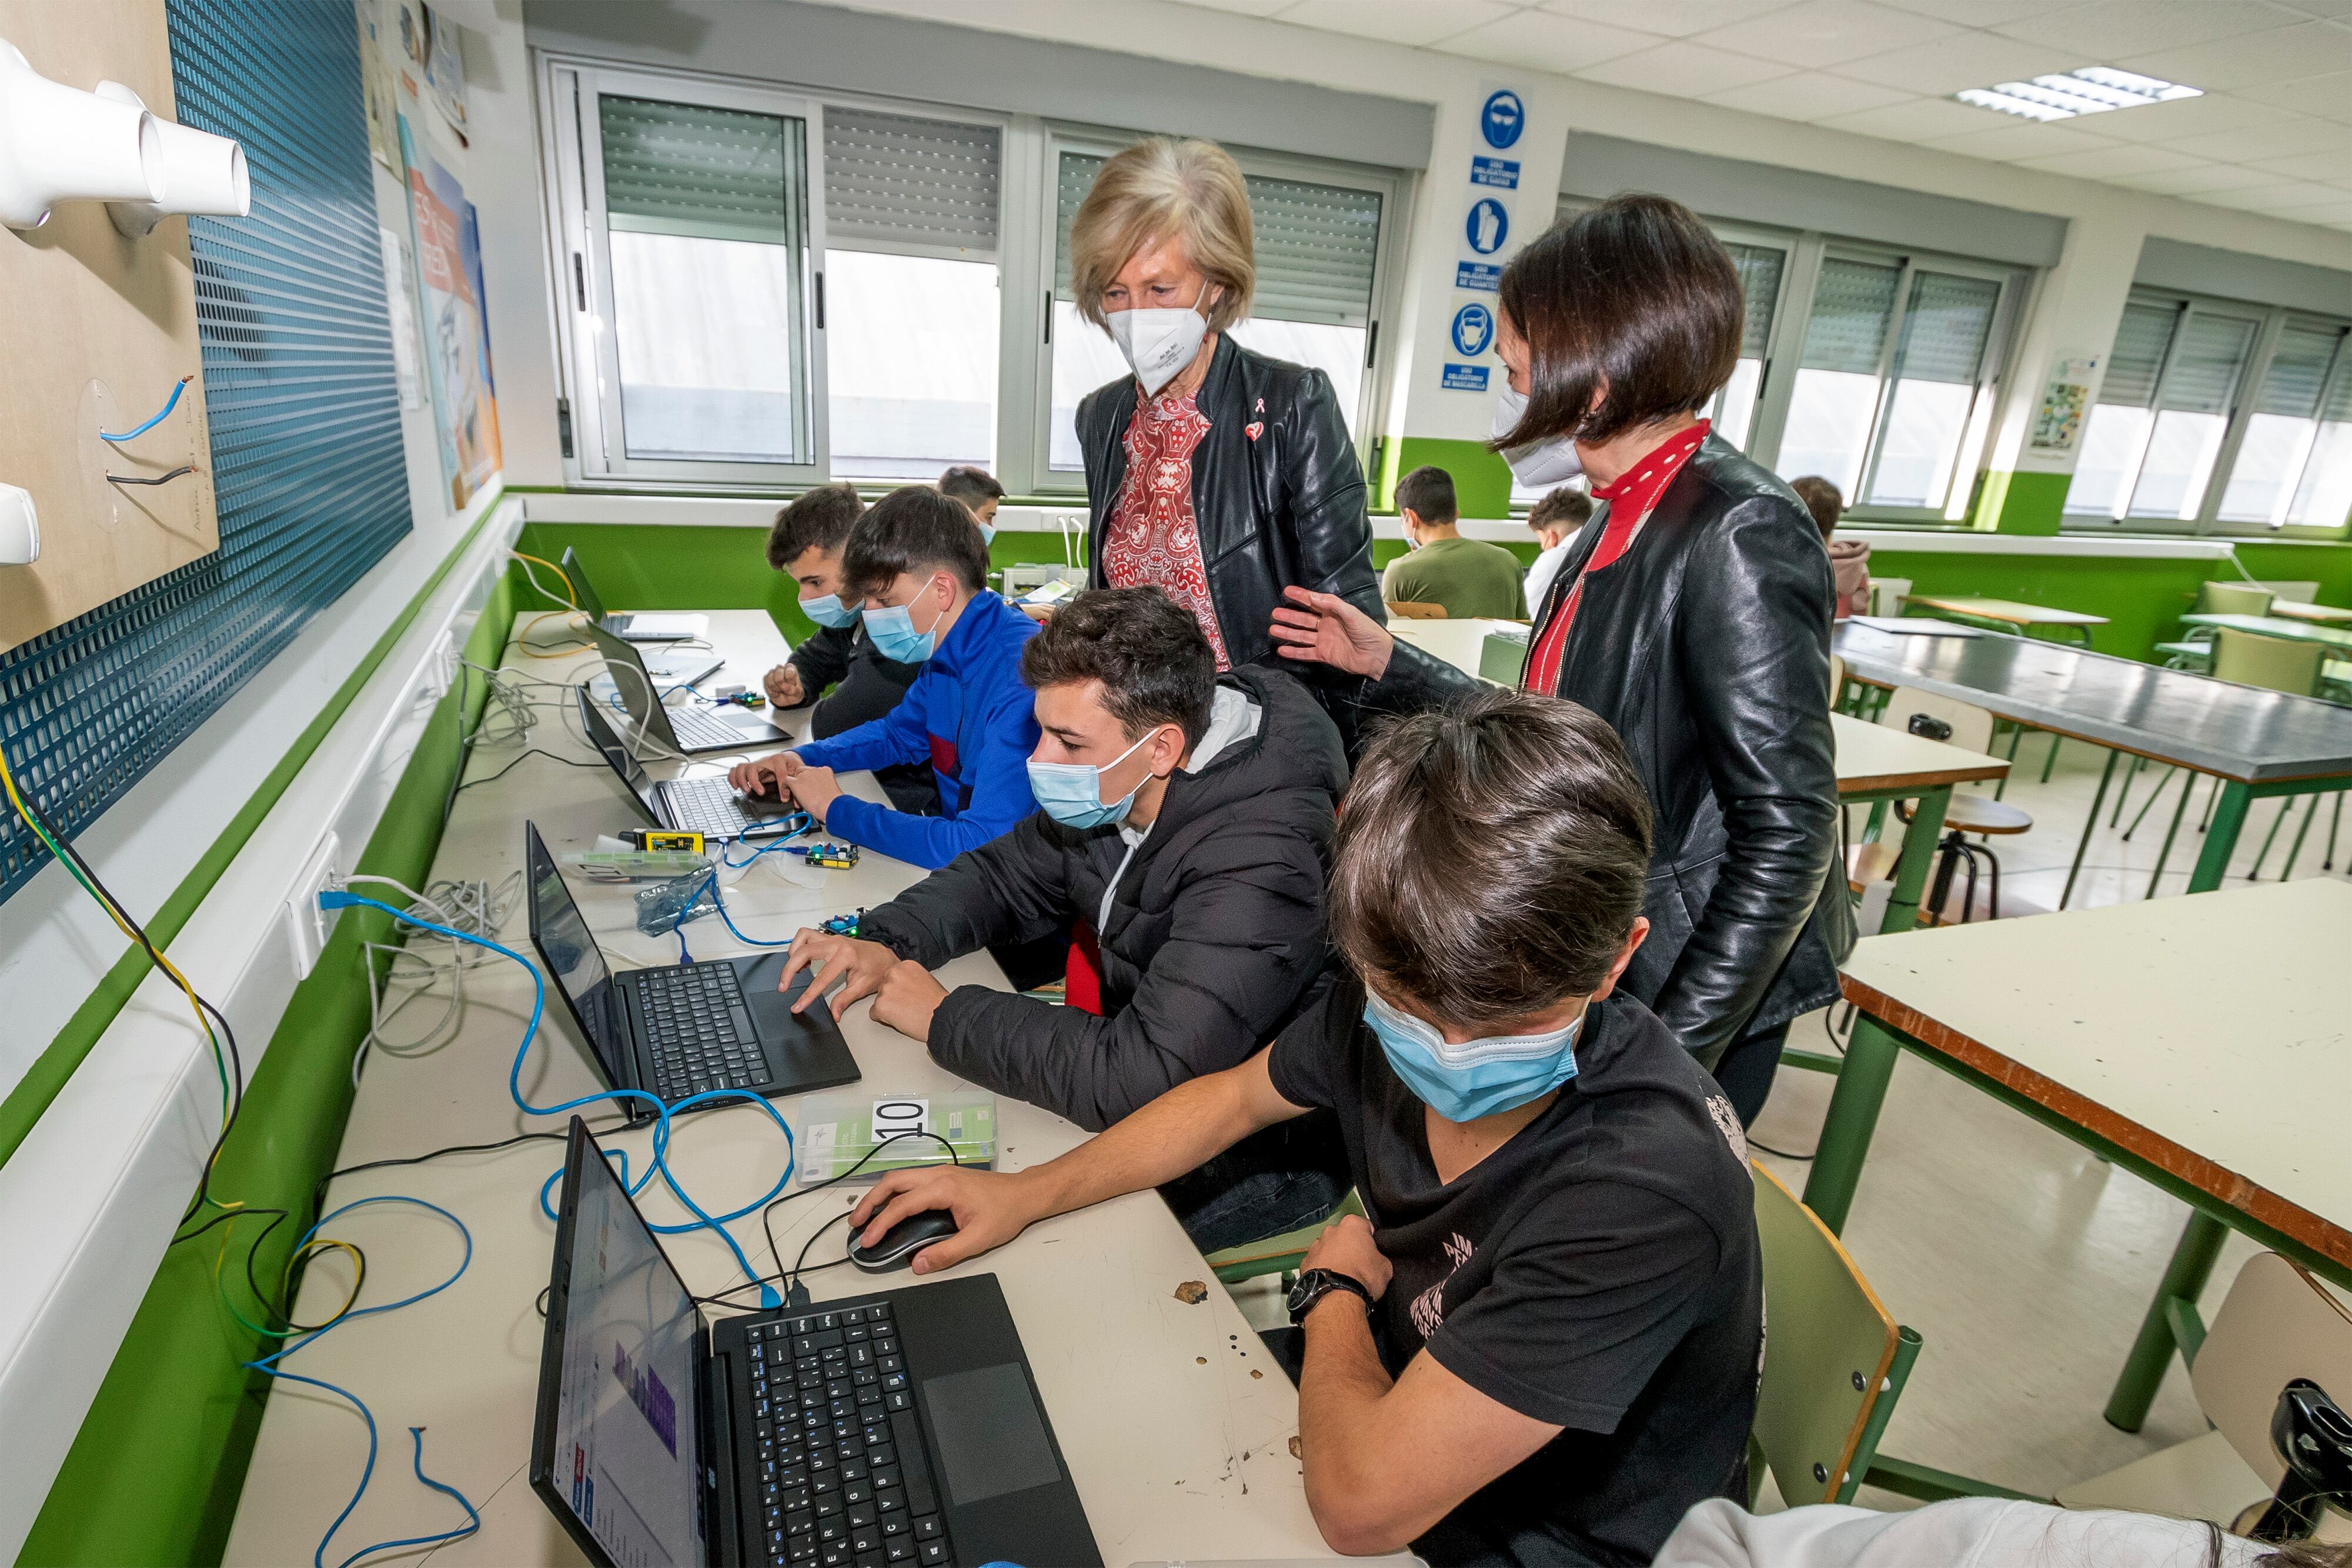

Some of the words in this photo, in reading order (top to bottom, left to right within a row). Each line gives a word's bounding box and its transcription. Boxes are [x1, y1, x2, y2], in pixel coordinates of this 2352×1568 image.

[1474, 166, 1517, 179] OBLIGATORIO
[1475, 265, 1488, 273] USO
[1459, 271, 1500, 282] OBLIGATORI
[1470, 279, 1498, 288] GUANTE
[1448, 373, 1484, 382] OBLIGATORIO
[875, 1102, 924, 1139] 10
